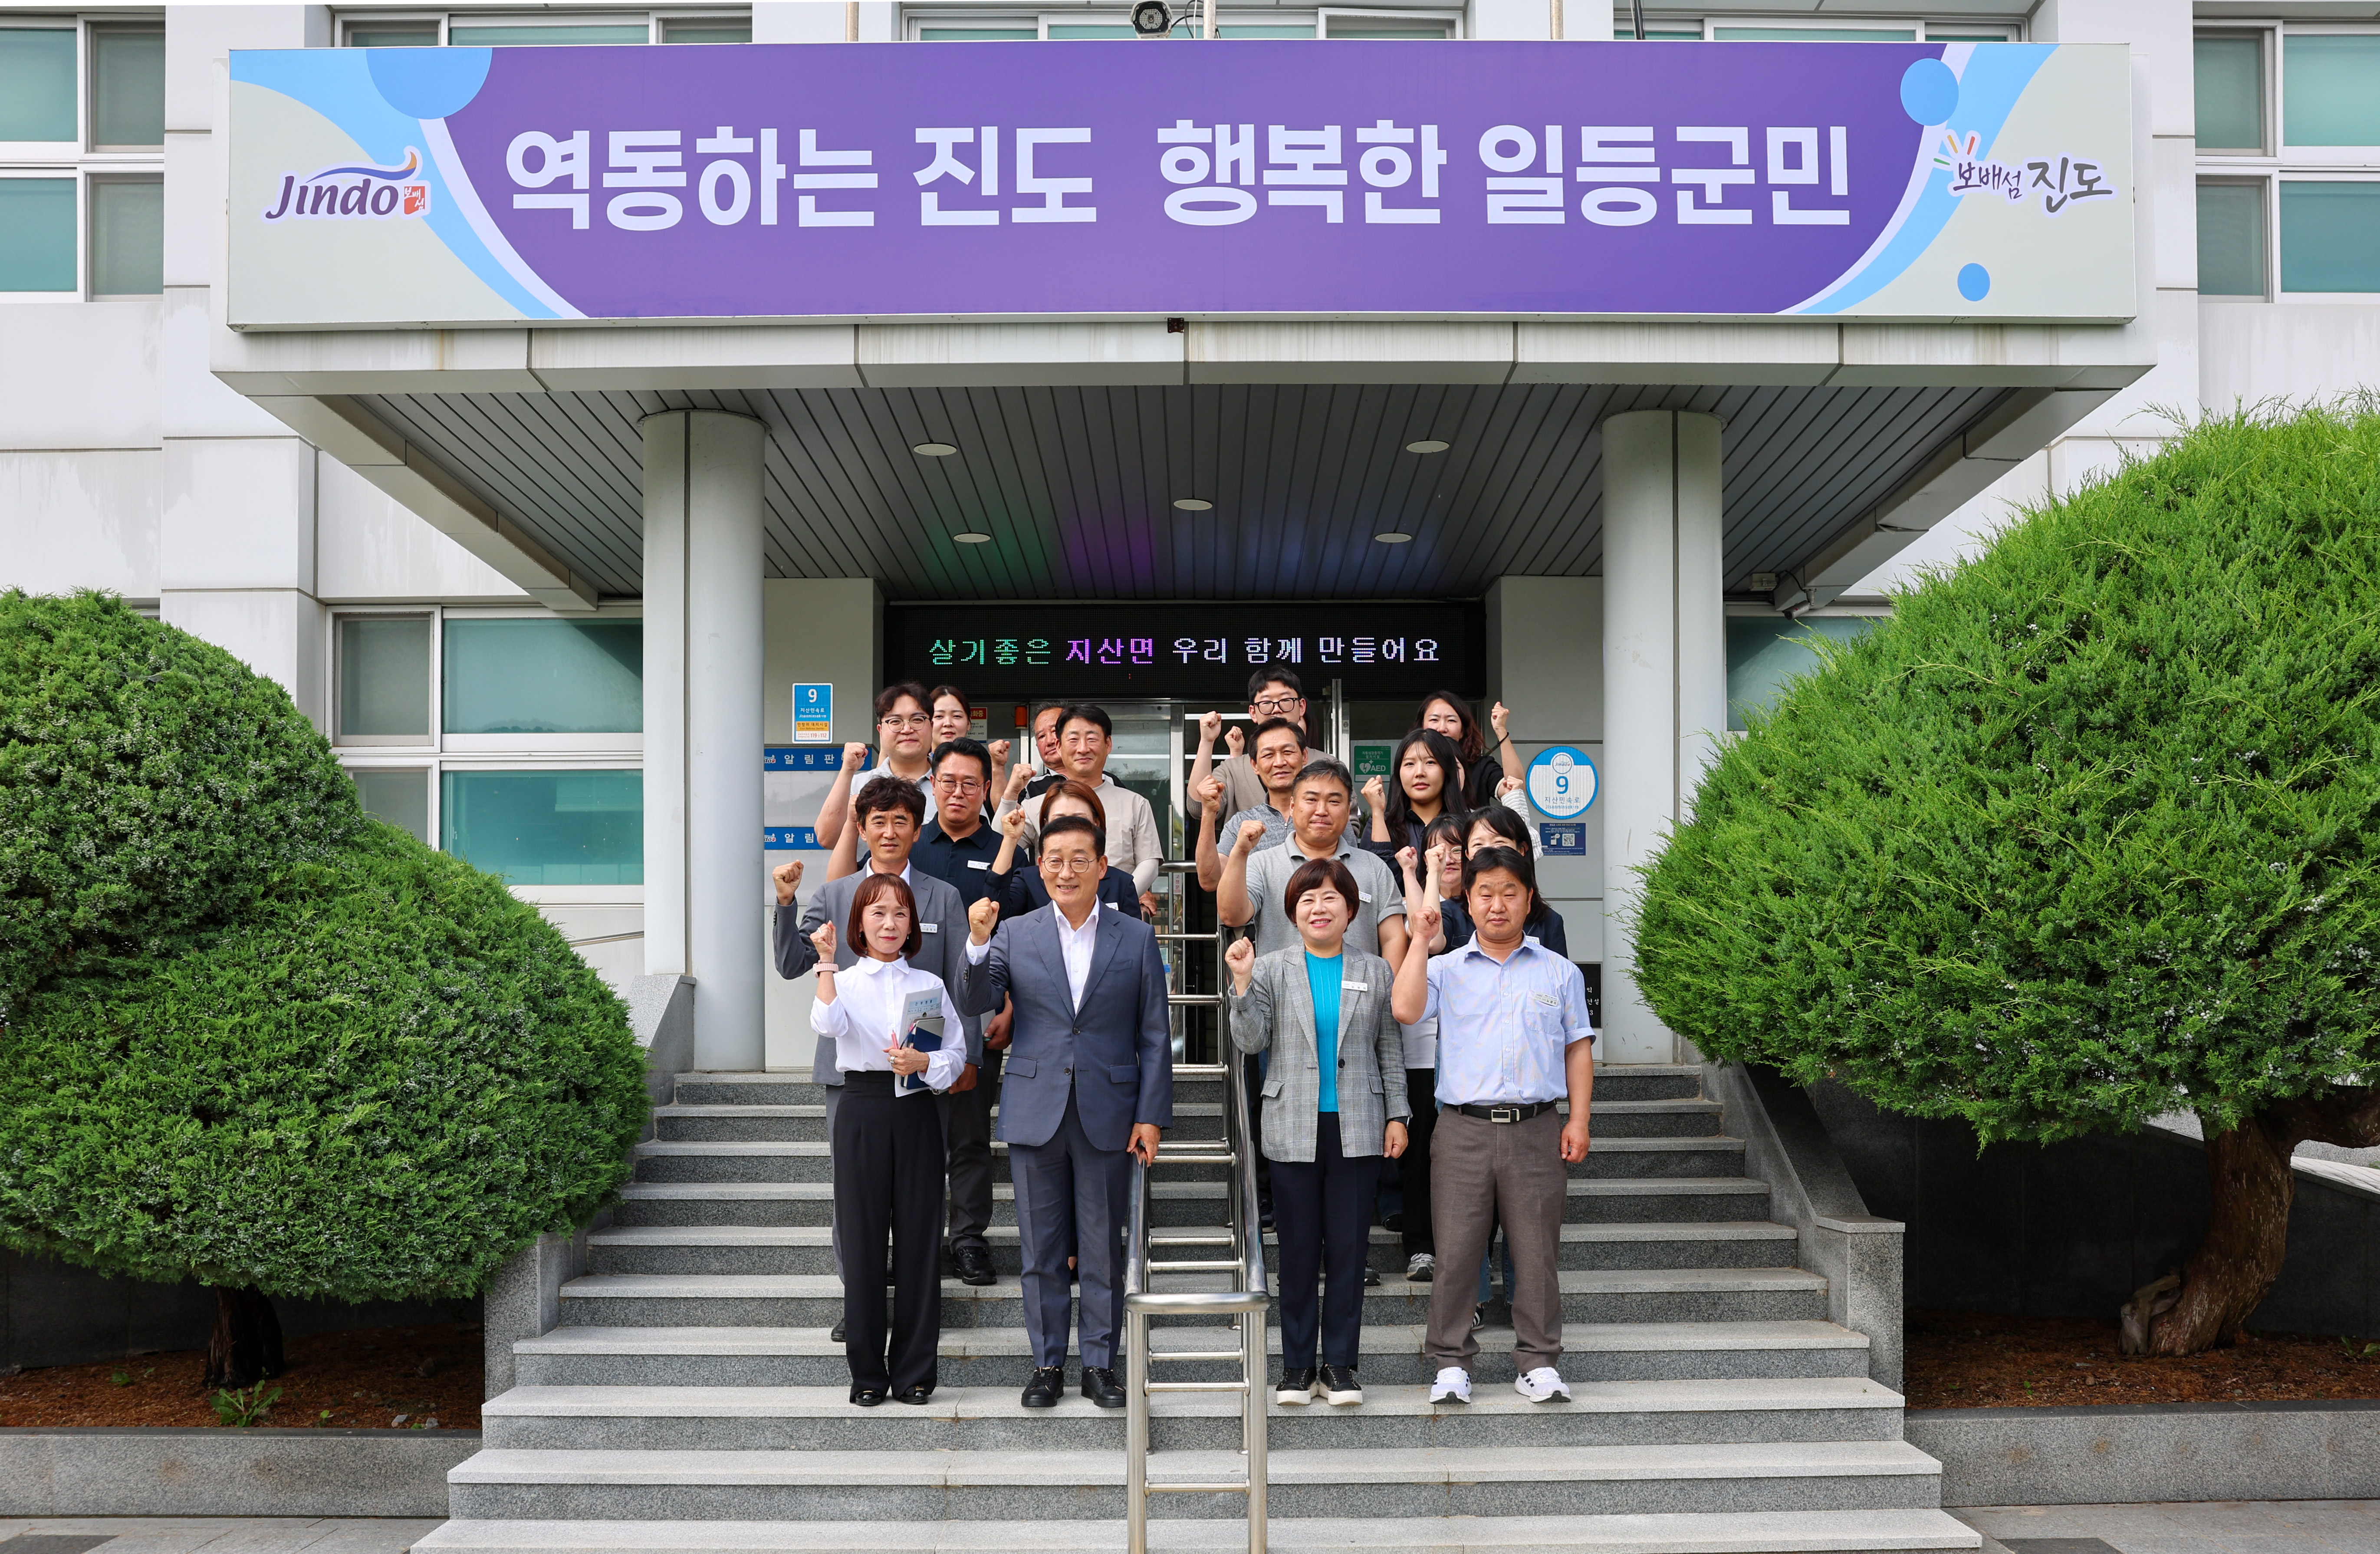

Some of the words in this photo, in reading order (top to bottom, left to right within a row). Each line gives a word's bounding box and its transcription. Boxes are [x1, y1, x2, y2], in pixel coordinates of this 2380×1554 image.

[506, 126, 878, 231] 역동하는
[914, 126, 1097, 226] 진도
[1157, 119, 1447, 226] 행복한
[1479, 125, 1850, 226] 일등군민
[1953, 161, 2023, 199] 보배섬
[2027, 157, 2113, 213] 진도
[265, 175, 398, 219] Jindo
[404, 187, 425, 211] 보배섬
[929, 639, 1051, 665] 살기좋은
[1066, 638, 1154, 664] 지산면
[1173, 638, 1226, 664] 우리
[1244, 638, 1302, 664] 함께
[1319, 637, 1440, 663] 만들어요
[808, 688, 817, 703] 9
[1556, 776, 1568, 794] 9
